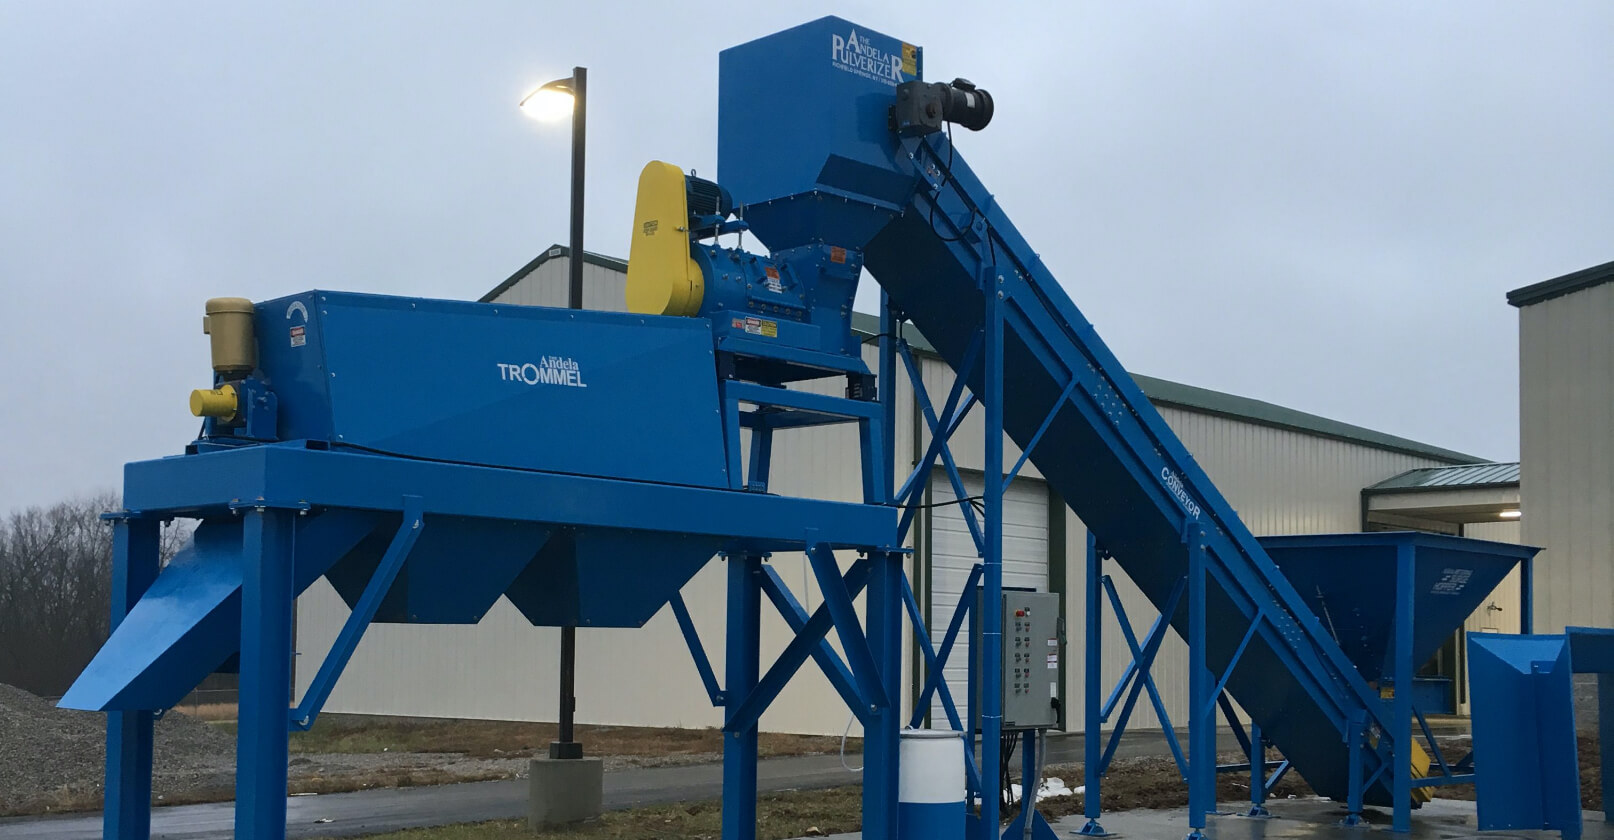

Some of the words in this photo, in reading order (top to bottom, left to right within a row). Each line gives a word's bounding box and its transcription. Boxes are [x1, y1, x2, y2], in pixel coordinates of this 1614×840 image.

[846, 28, 889, 64] ANDELA
[860, 36, 870, 45] THE
[832, 34, 904, 82] PULVERIZER
[497, 363, 587, 388] TROMMEL
[540, 355, 579, 370] Andela
[1161, 467, 1200, 520] CONVEYOR
